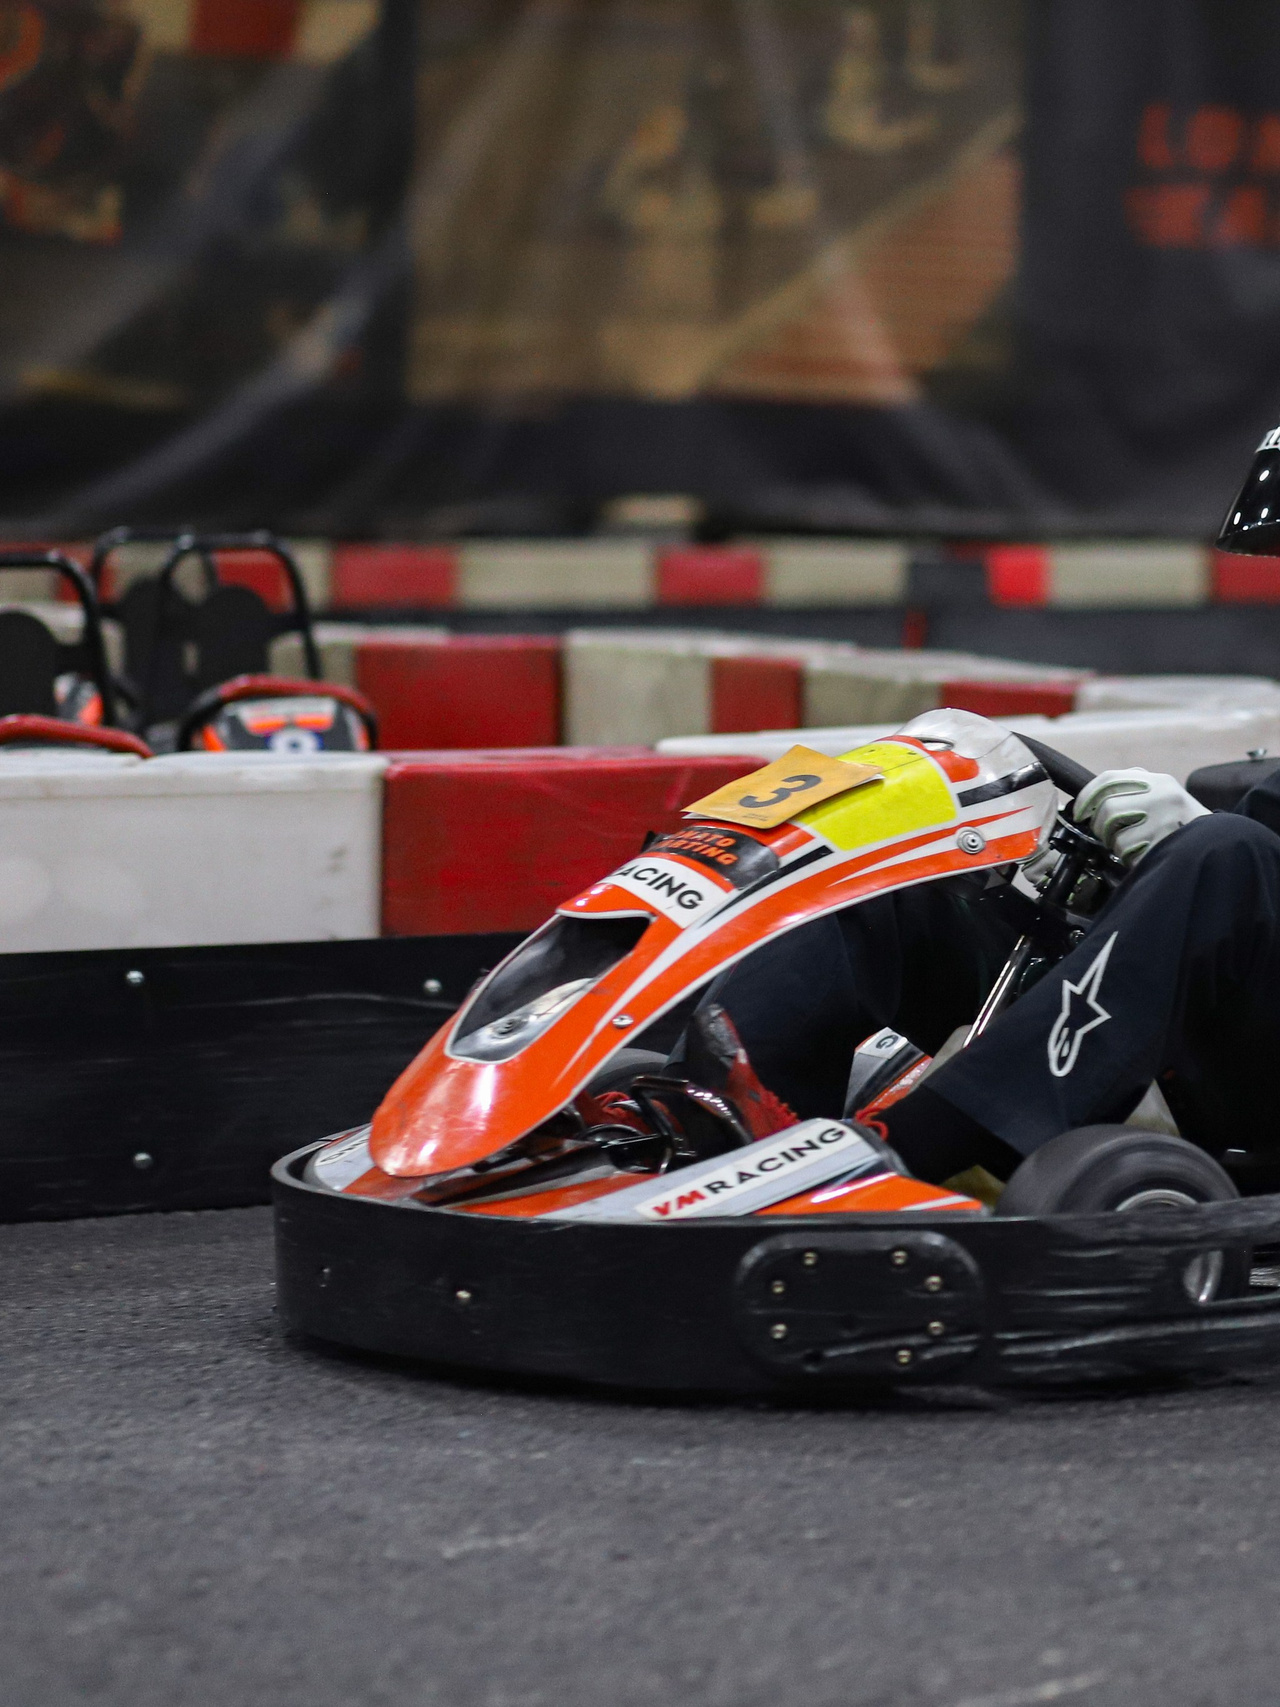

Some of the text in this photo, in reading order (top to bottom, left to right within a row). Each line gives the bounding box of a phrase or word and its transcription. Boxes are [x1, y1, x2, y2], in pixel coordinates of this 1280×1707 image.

[738, 774, 822, 809] 3
[611, 864, 703, 910] ACING
[652, 1127, 846, 1217] VM RACING
